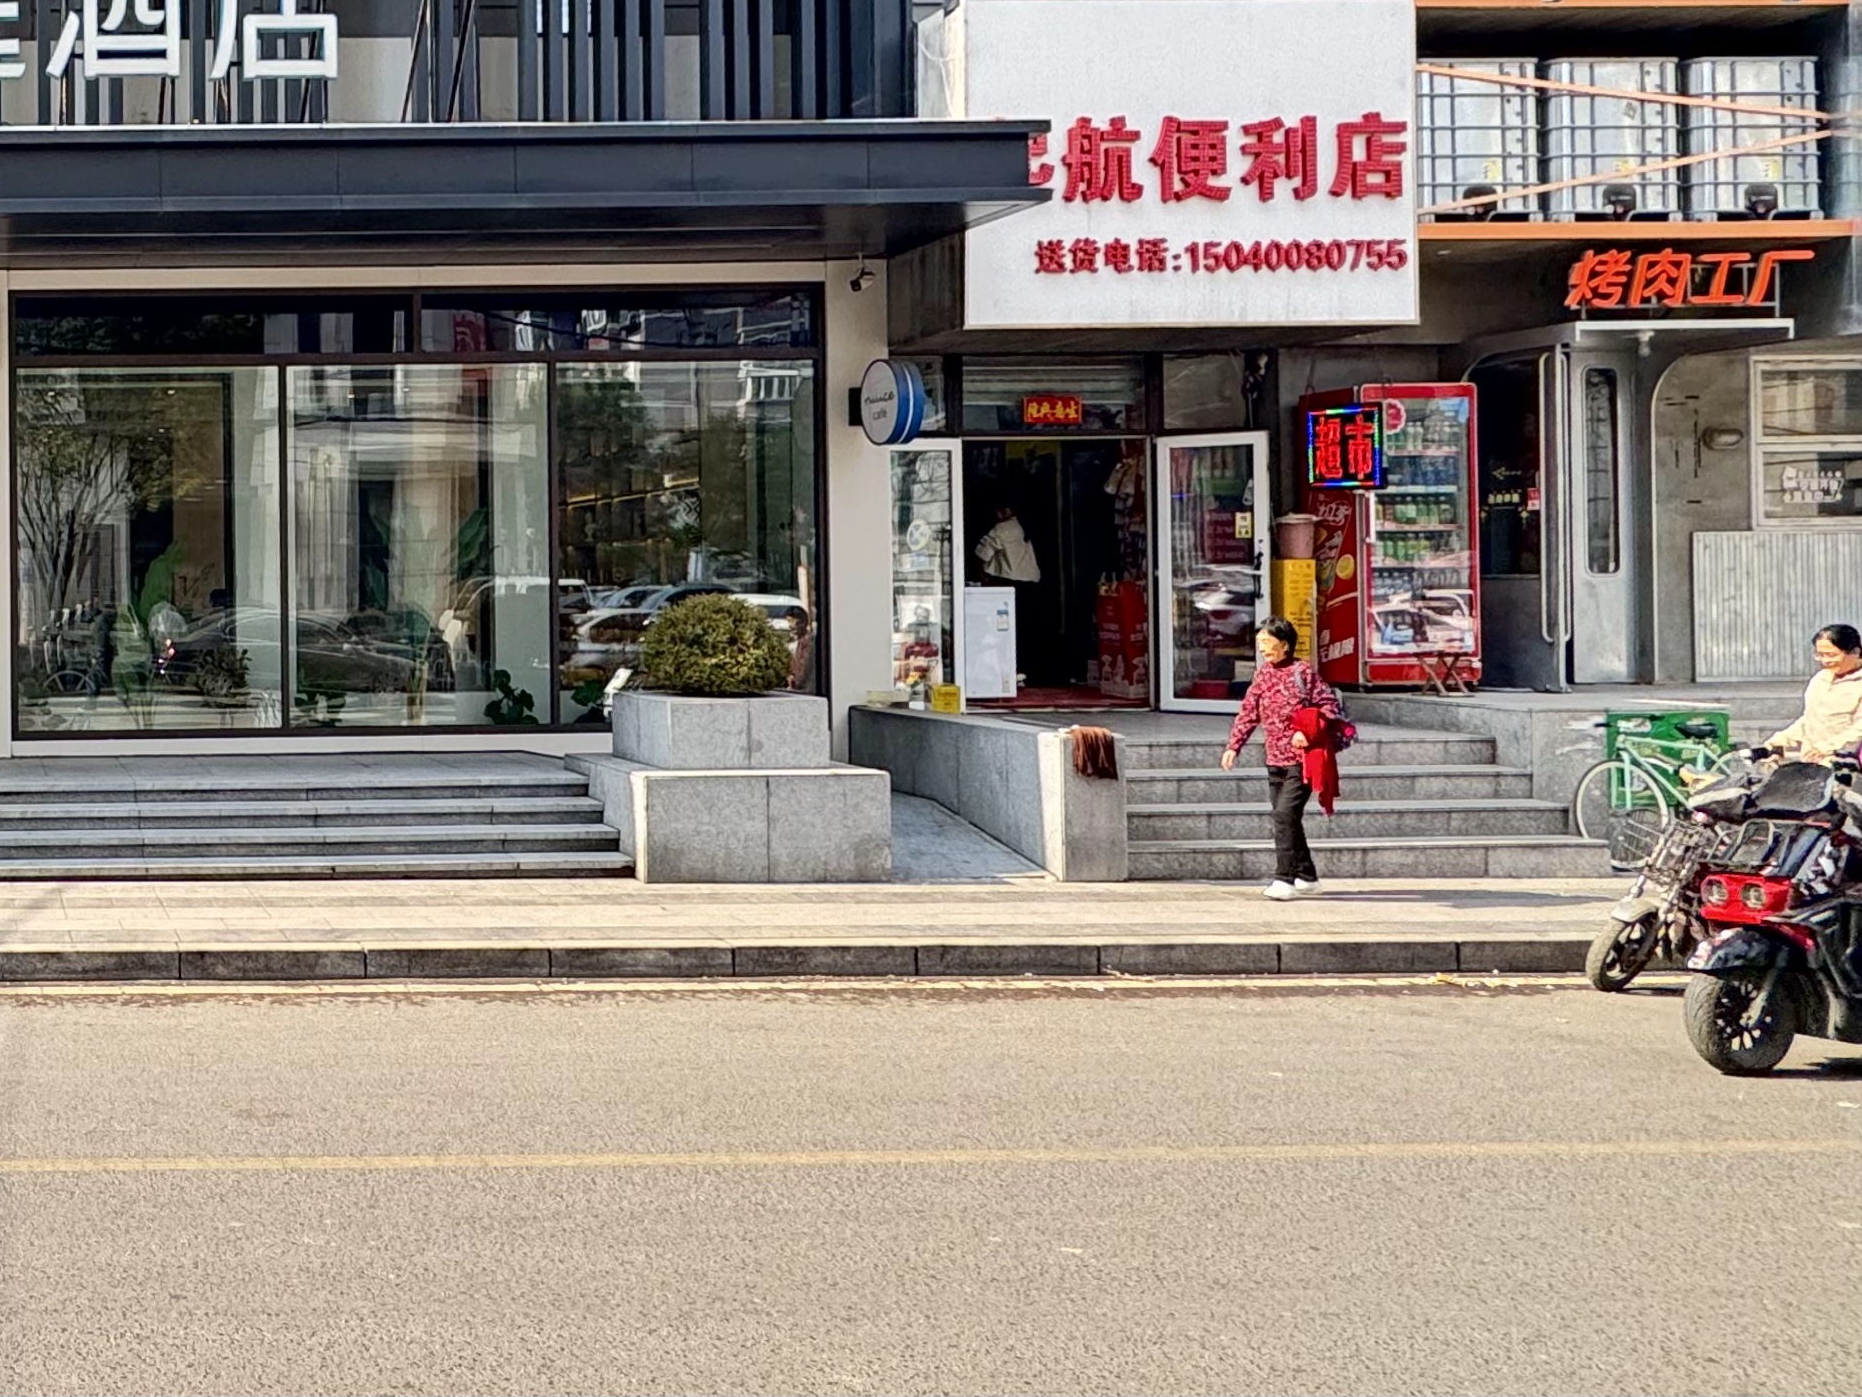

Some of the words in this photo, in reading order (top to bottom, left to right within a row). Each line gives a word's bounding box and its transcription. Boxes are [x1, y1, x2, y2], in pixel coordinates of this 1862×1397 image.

[1034, 237, 1408, 274] 送货电话:15040080755
[1564, 247, 1815, 308] 烤肉工厂
[1315, 413, 1374, 479] 超市
